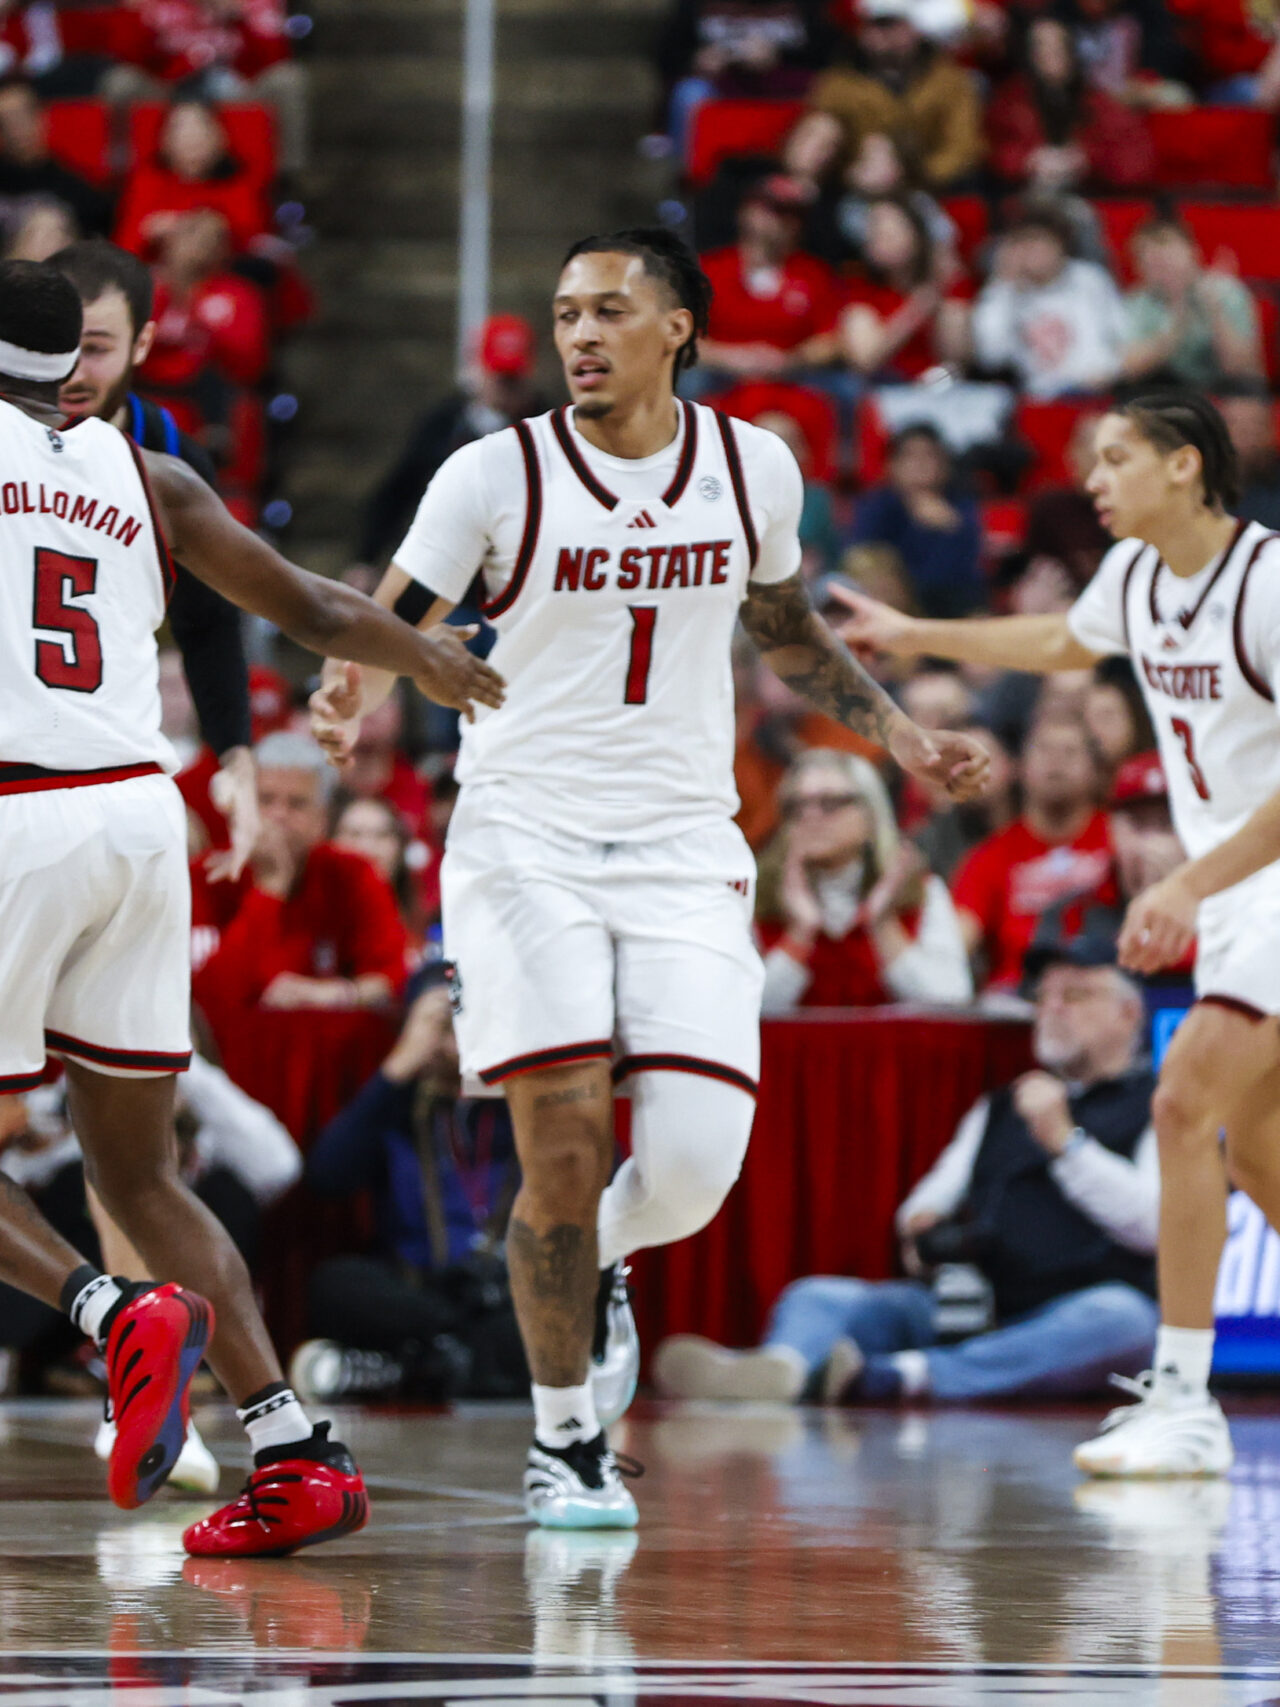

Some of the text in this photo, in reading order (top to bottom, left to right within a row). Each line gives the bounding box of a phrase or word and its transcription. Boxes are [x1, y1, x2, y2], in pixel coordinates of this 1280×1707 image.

[553, 539, 733, 592] NC STATE
[32, 546, 103, 694] 5
[624, 604, 658, 705] 1
[1171, 717, 1211, 801] 3
